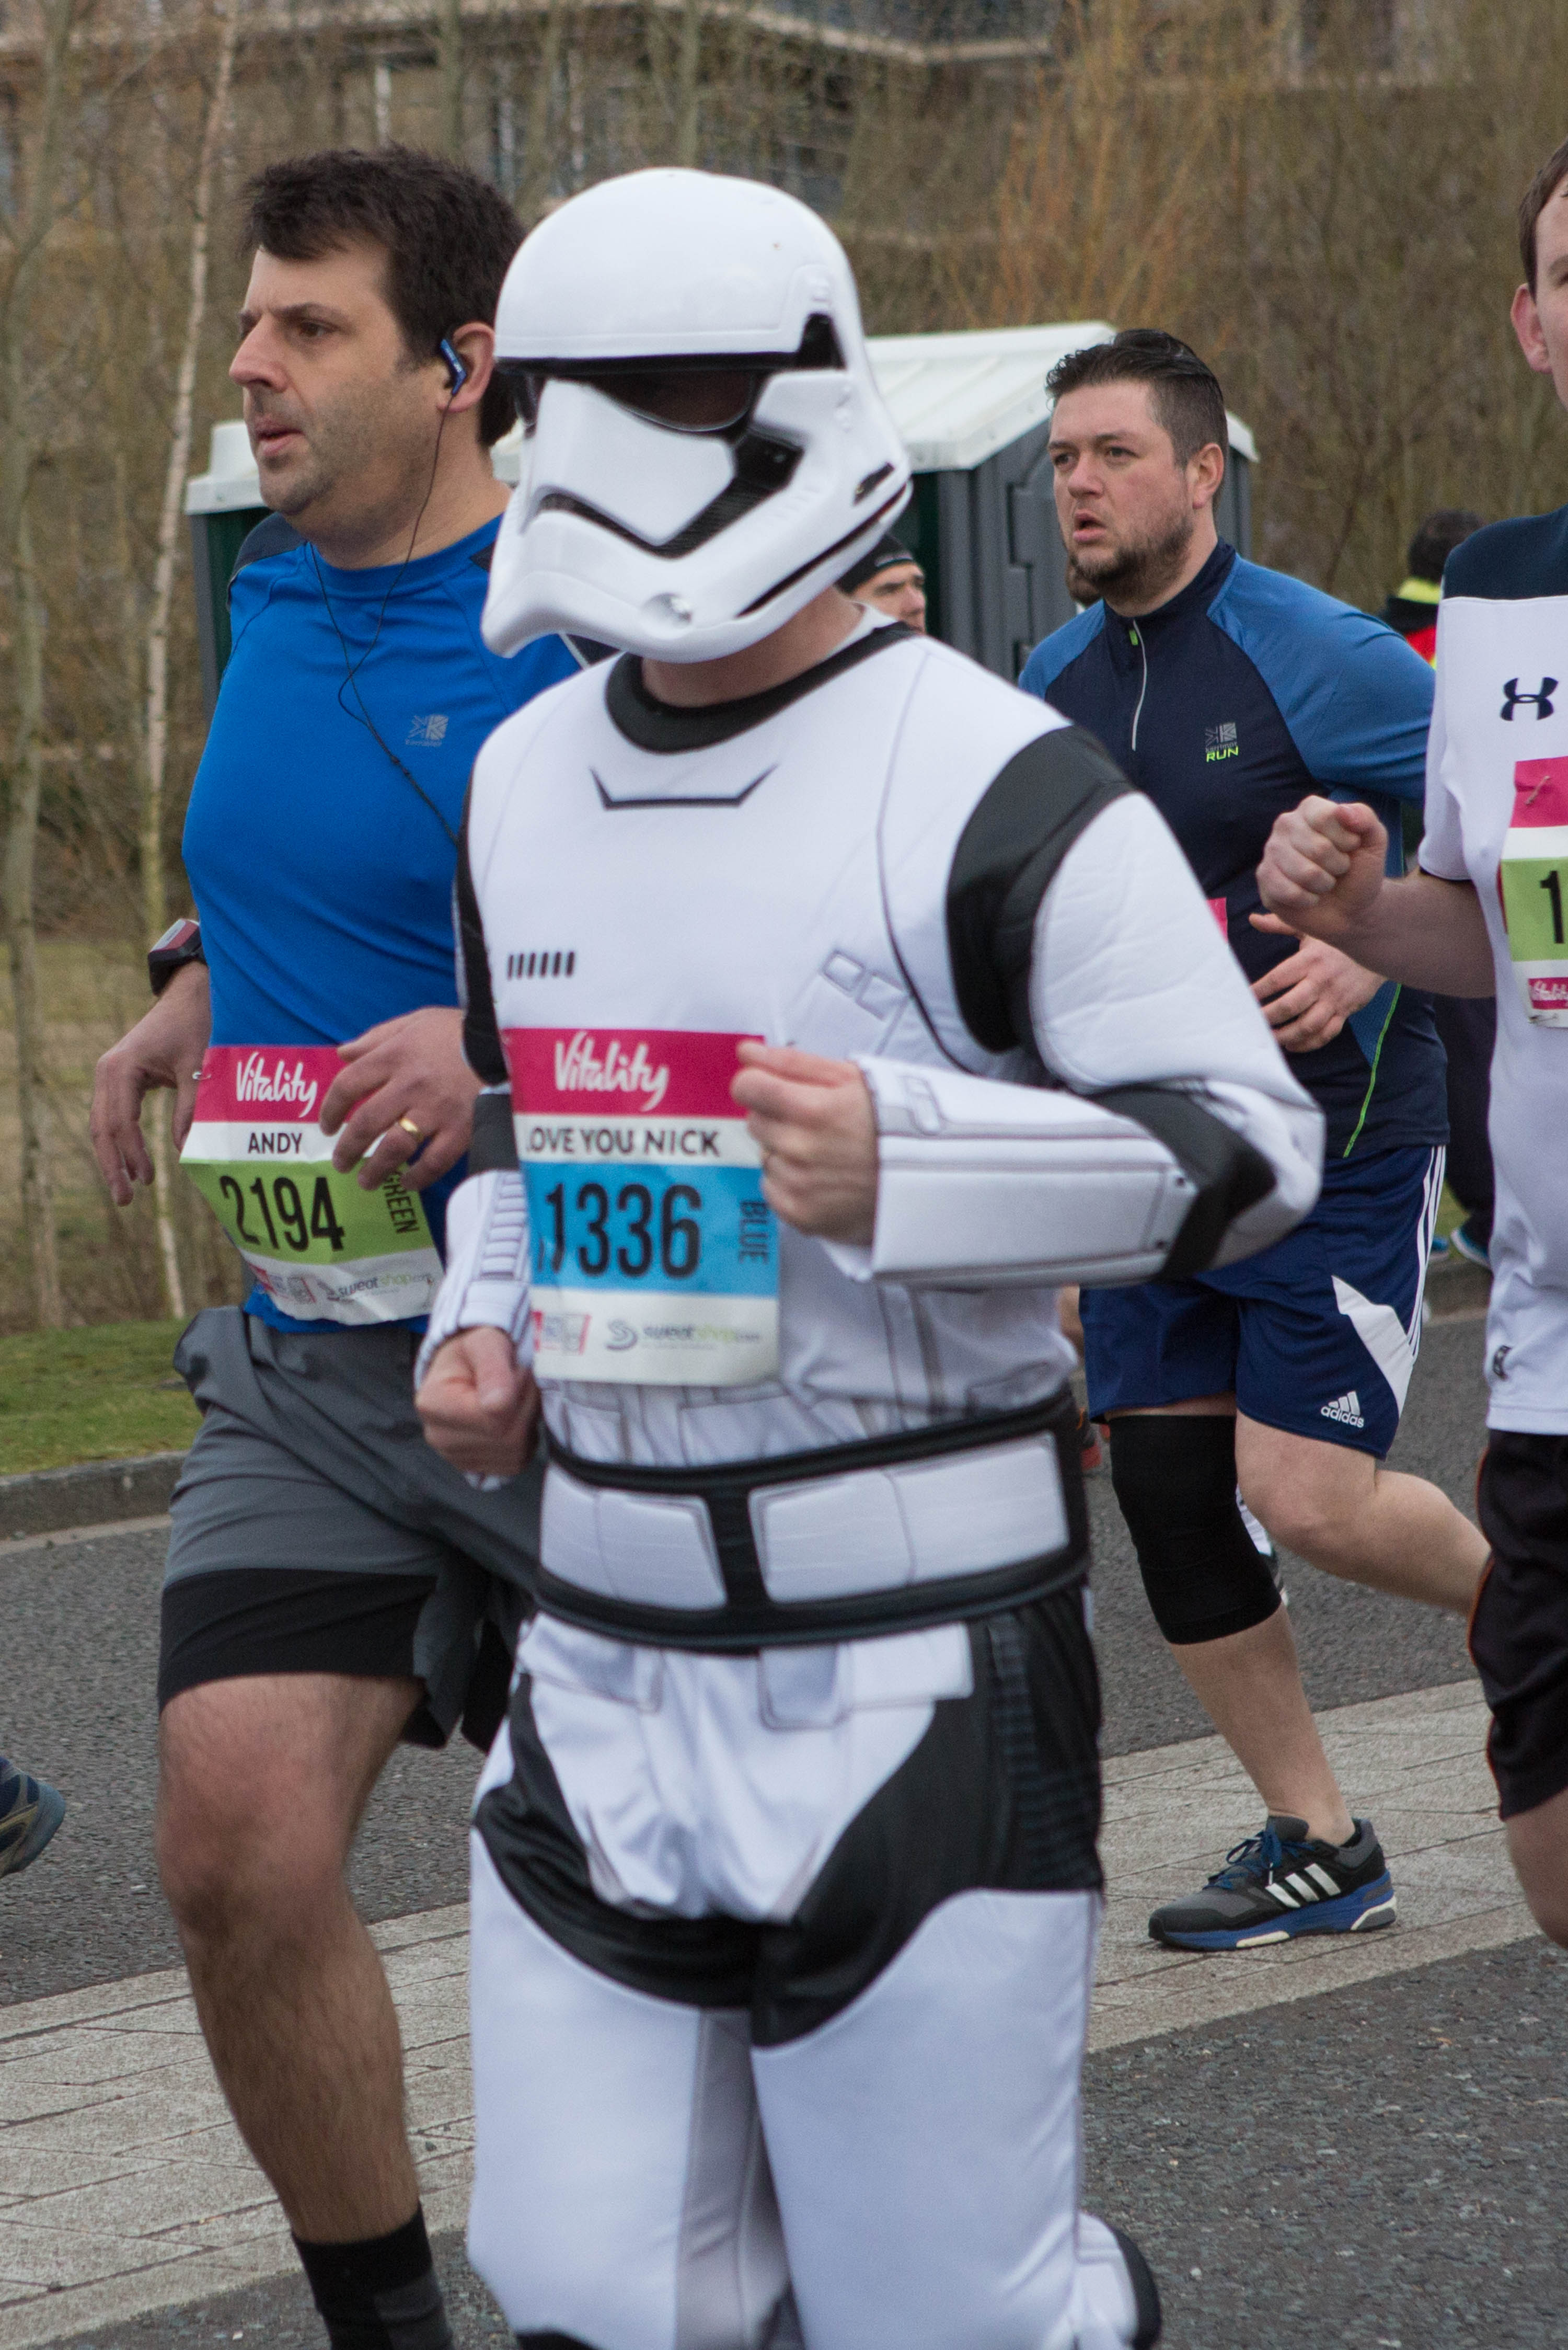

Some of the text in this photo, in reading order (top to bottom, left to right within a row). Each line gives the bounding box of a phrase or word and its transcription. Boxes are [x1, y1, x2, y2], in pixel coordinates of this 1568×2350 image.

[1206, 746, 1239, 763] RUN
[1540, 870, 1565, 944] 1
[236, 1051, 318, 1118] Vitality
[554, 1030, 669, 1112] Vitality
[247, 1132, 303, 1154] ANDY
[526, 1127, 721, 1157] OVE YOU NICK
[220, 1175, 345, 1252] 2194
[537, 1182, 702, 1280] 1336
[739, 1200, 769, 1265] BLUE
[1320, 1406, 1365, 1428] adidas
